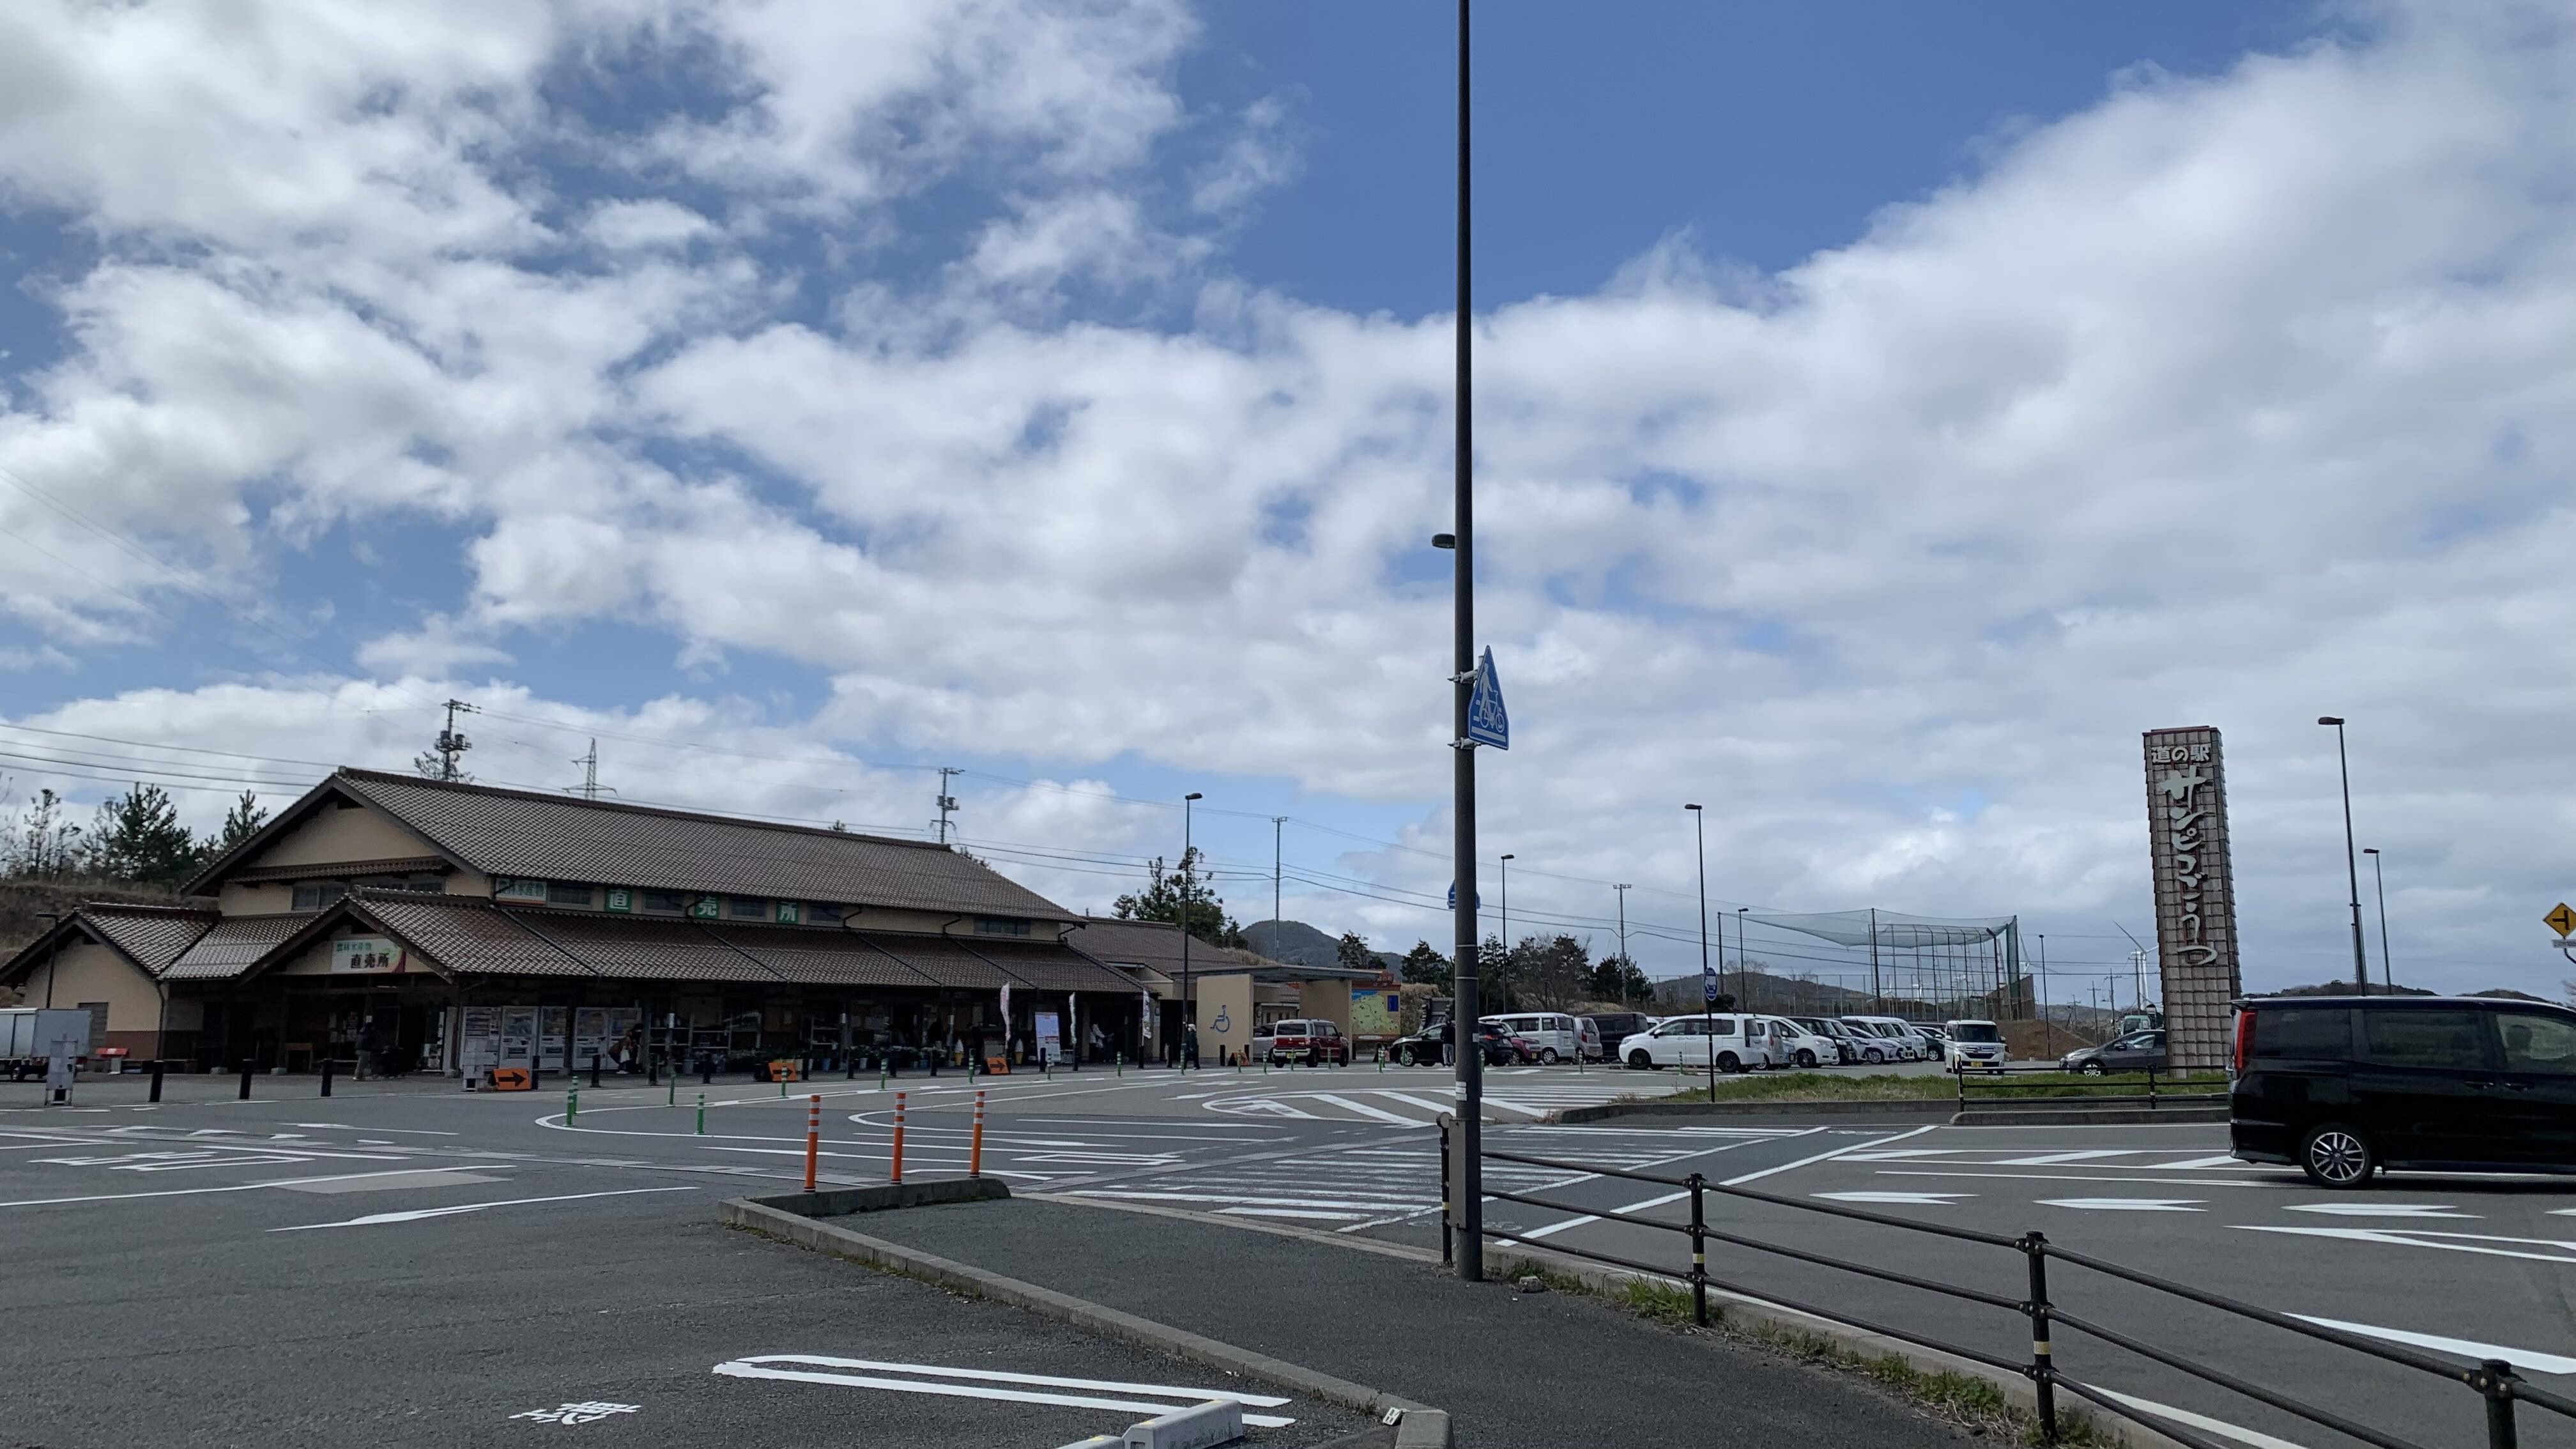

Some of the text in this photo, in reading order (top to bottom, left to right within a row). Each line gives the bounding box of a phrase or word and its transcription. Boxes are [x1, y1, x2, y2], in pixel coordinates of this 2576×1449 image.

[2151, 745, 2211, 763] 道の駅
[2160, 765, 2218, 965] サンピコごうつ
[608, 889, 797, 922] 直売所
[351, 953, 389, 969] 直売所
